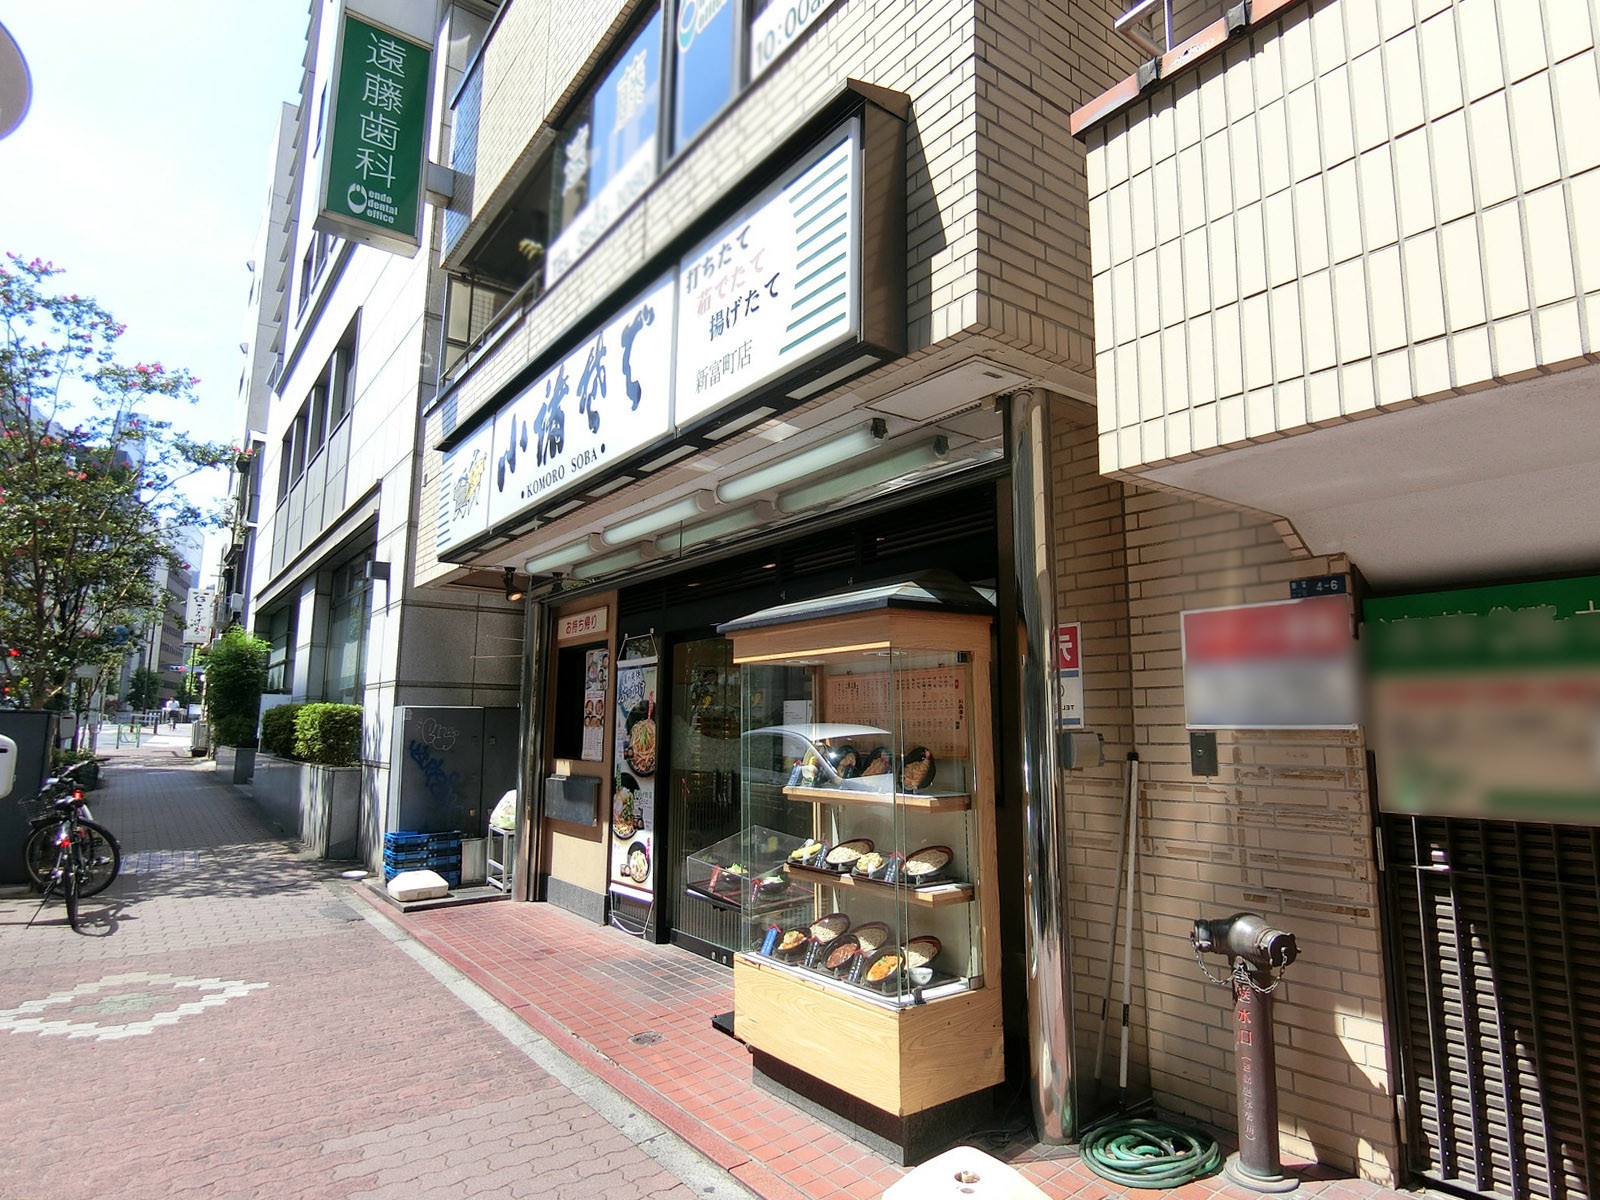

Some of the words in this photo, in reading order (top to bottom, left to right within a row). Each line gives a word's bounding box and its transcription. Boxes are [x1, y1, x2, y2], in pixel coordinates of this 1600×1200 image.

[355, 32, 407, 188] 遠藤歯科
[368, 190, 392, 204] endo
[368, 199, 398, 216] dental
[367, 209, 394, 224] office
[686, 225, 751, 294] 打ちたて
[709, 272, 780, 342] 揚げたて
[695, 339, 752, 394] 新富町店
[526, 464, 566, 499] KOMORO
[571, 450, 598, 474] SOBA
[1315, 580, 1338, 591] 4-6
[565, 614, 597, 635] お持ち帰り
